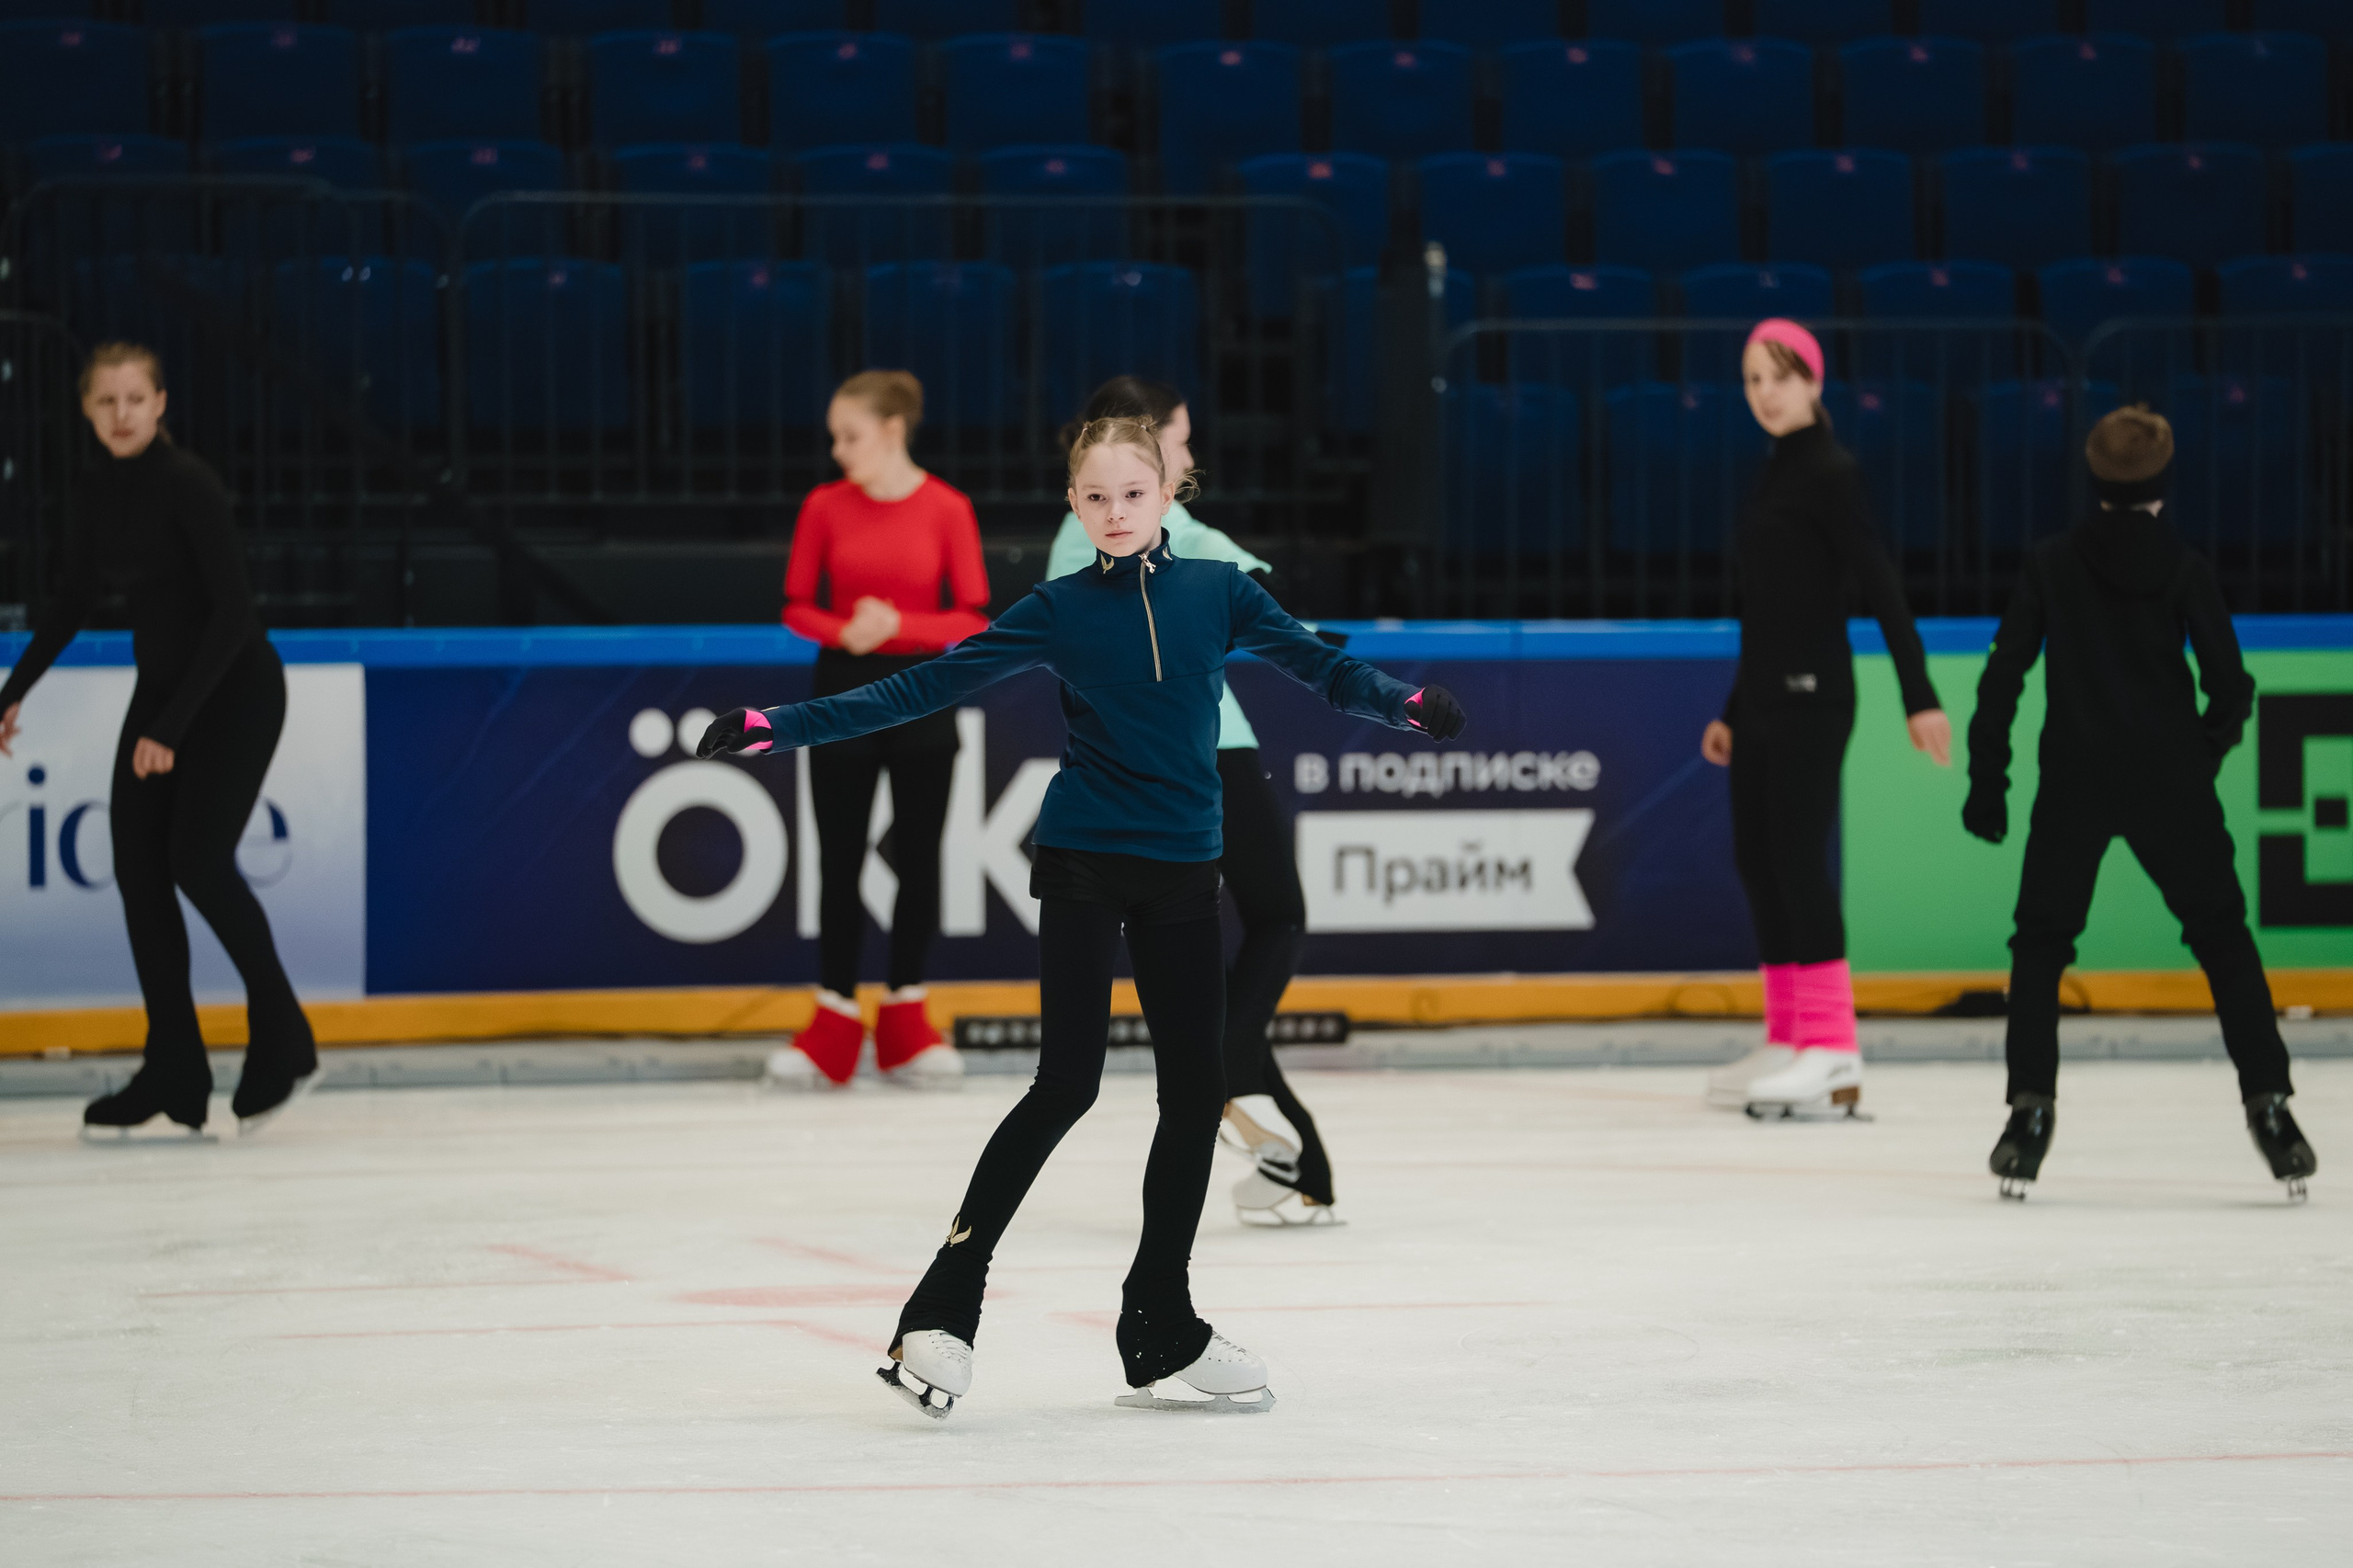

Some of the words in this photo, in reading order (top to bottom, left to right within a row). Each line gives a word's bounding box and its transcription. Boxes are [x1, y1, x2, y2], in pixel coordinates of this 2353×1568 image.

[1294, 753, 1329, 794] в
[1338, 750, 1602, 798] подписке
[1334, 840, 1533, 903] Прайм
